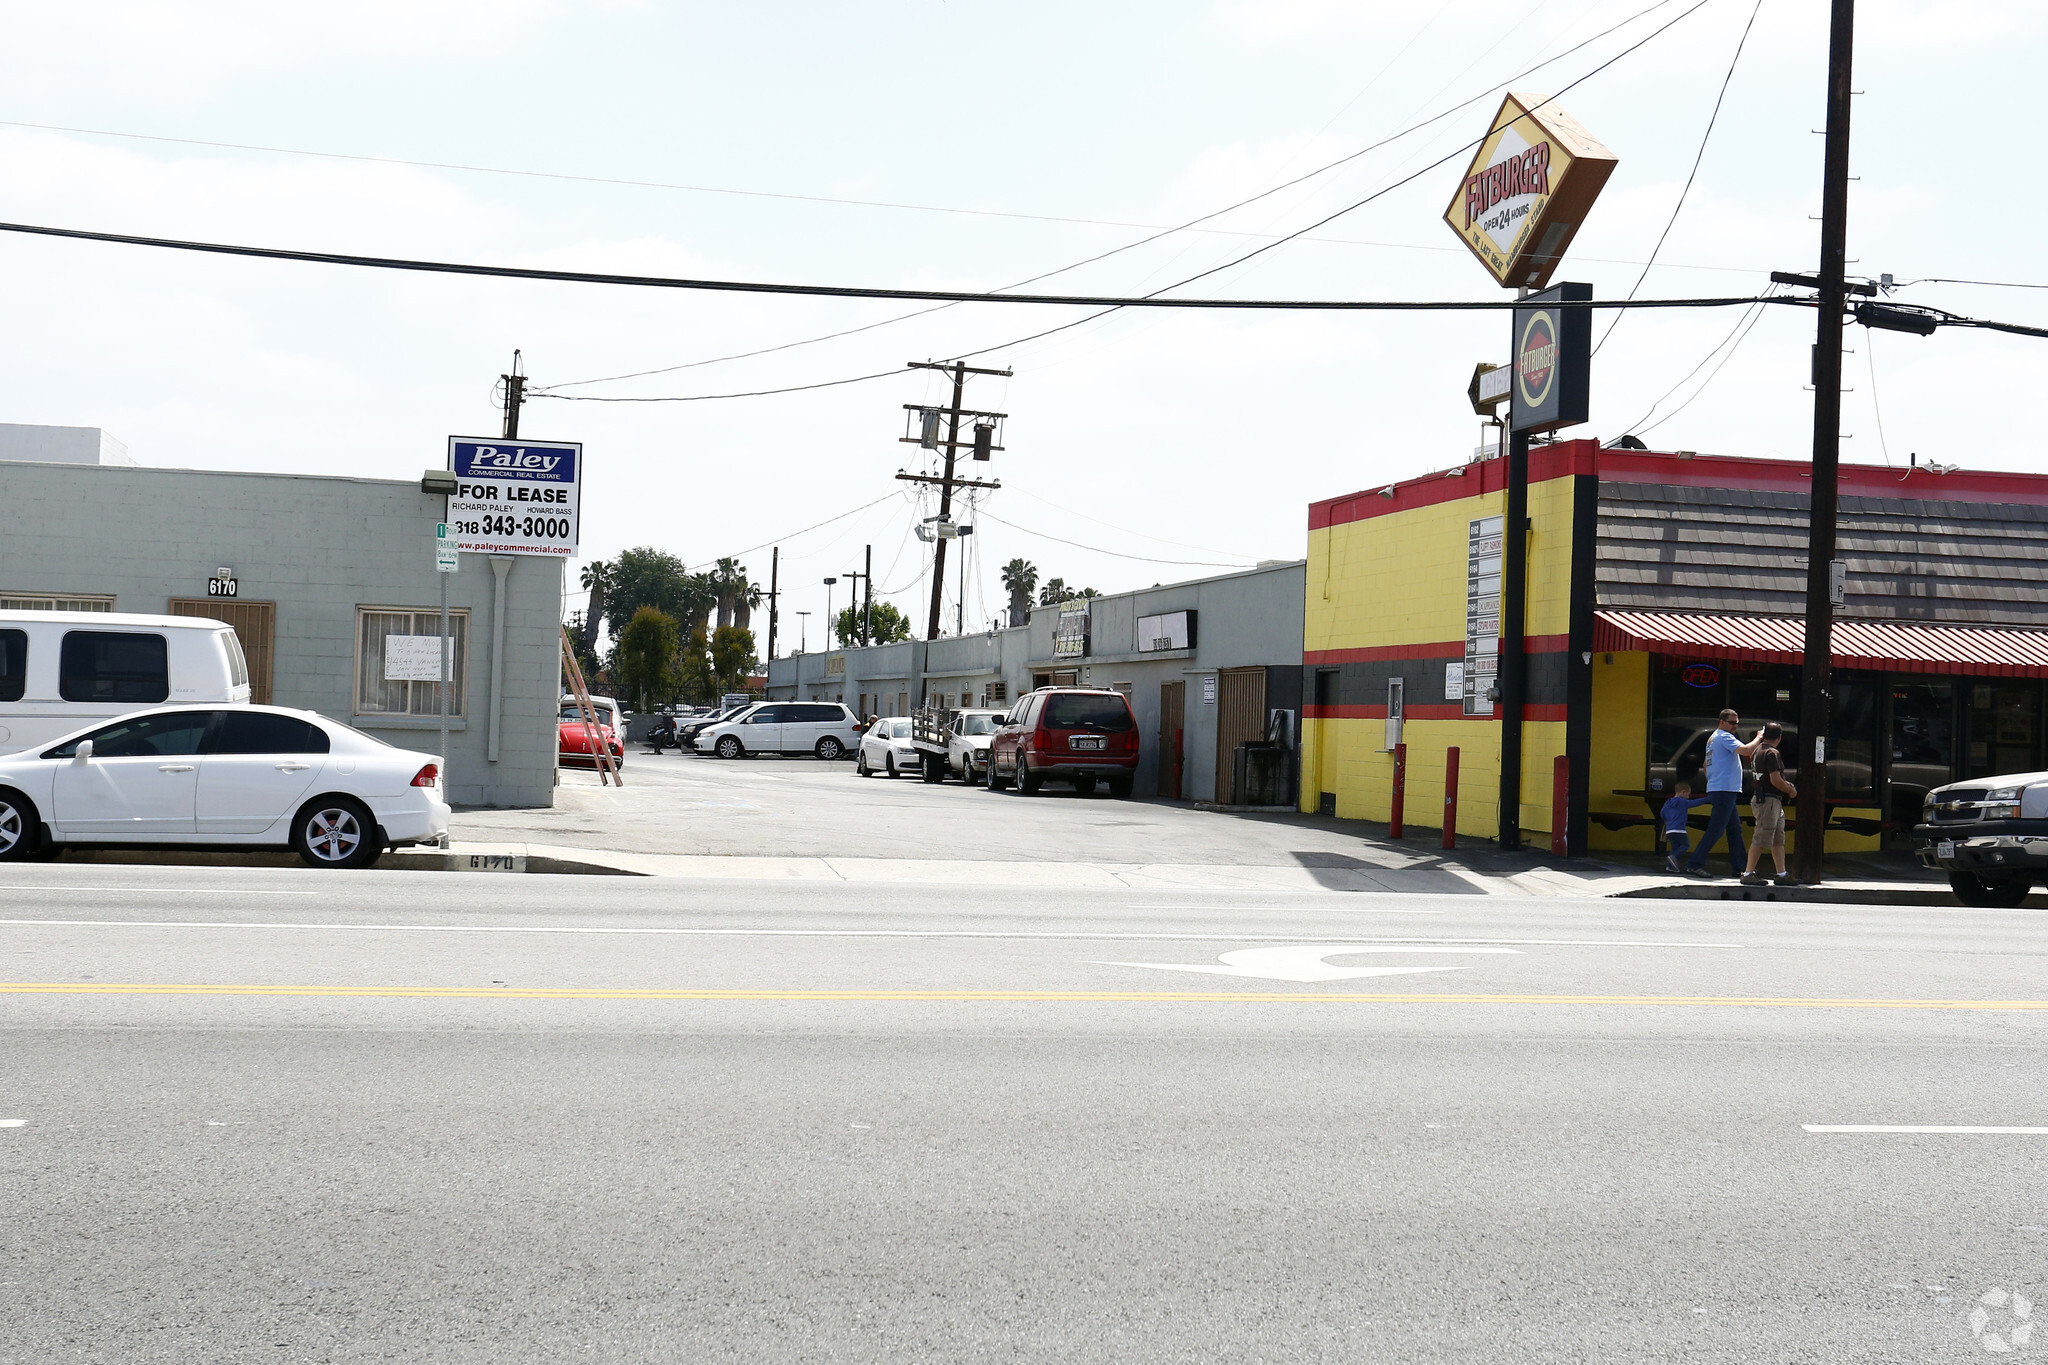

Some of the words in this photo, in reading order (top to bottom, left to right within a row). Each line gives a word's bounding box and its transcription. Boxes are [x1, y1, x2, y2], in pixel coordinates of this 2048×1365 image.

[1465, 141, 1550, 231] FATBURGER
[1483, 216, 1499, 232] OPEN
[1499, 208, 1511, 230] 24
[1511, 203, 1530, 220] HOURS
[1506, 224, 1531, 269] HAMBURGER
[1530, 199, 1545, 225] STAND
[1472, 231, 1480, 245] THE
[1490, 252, 1504, 272] GREAT
[1519, 342, 1556, 376] FATBURGER
[470, 446, 562, 472] Paley
[468, 469, 515, 478] COMMERCIAL
[459, 484, 499, 500] FOR
[507, 486, 568, 504] LEASE
[452, 502, 488, 511] RICHARD
[489, 504, 514, 513] PALEY
[527, 506, 555, 514] HOWARD
[555, 508, 573, 516] BASS
[482, 514, 570, 539] 343-3000
[437, 539, 458, 550] PARKING
[457, 541, 572, 555] ww.paleycommercial.com
[209, 579, 236, 595] 6170
[393, 638, 415, 648] WE
[1682, 669, 1720, 683] OPEN
